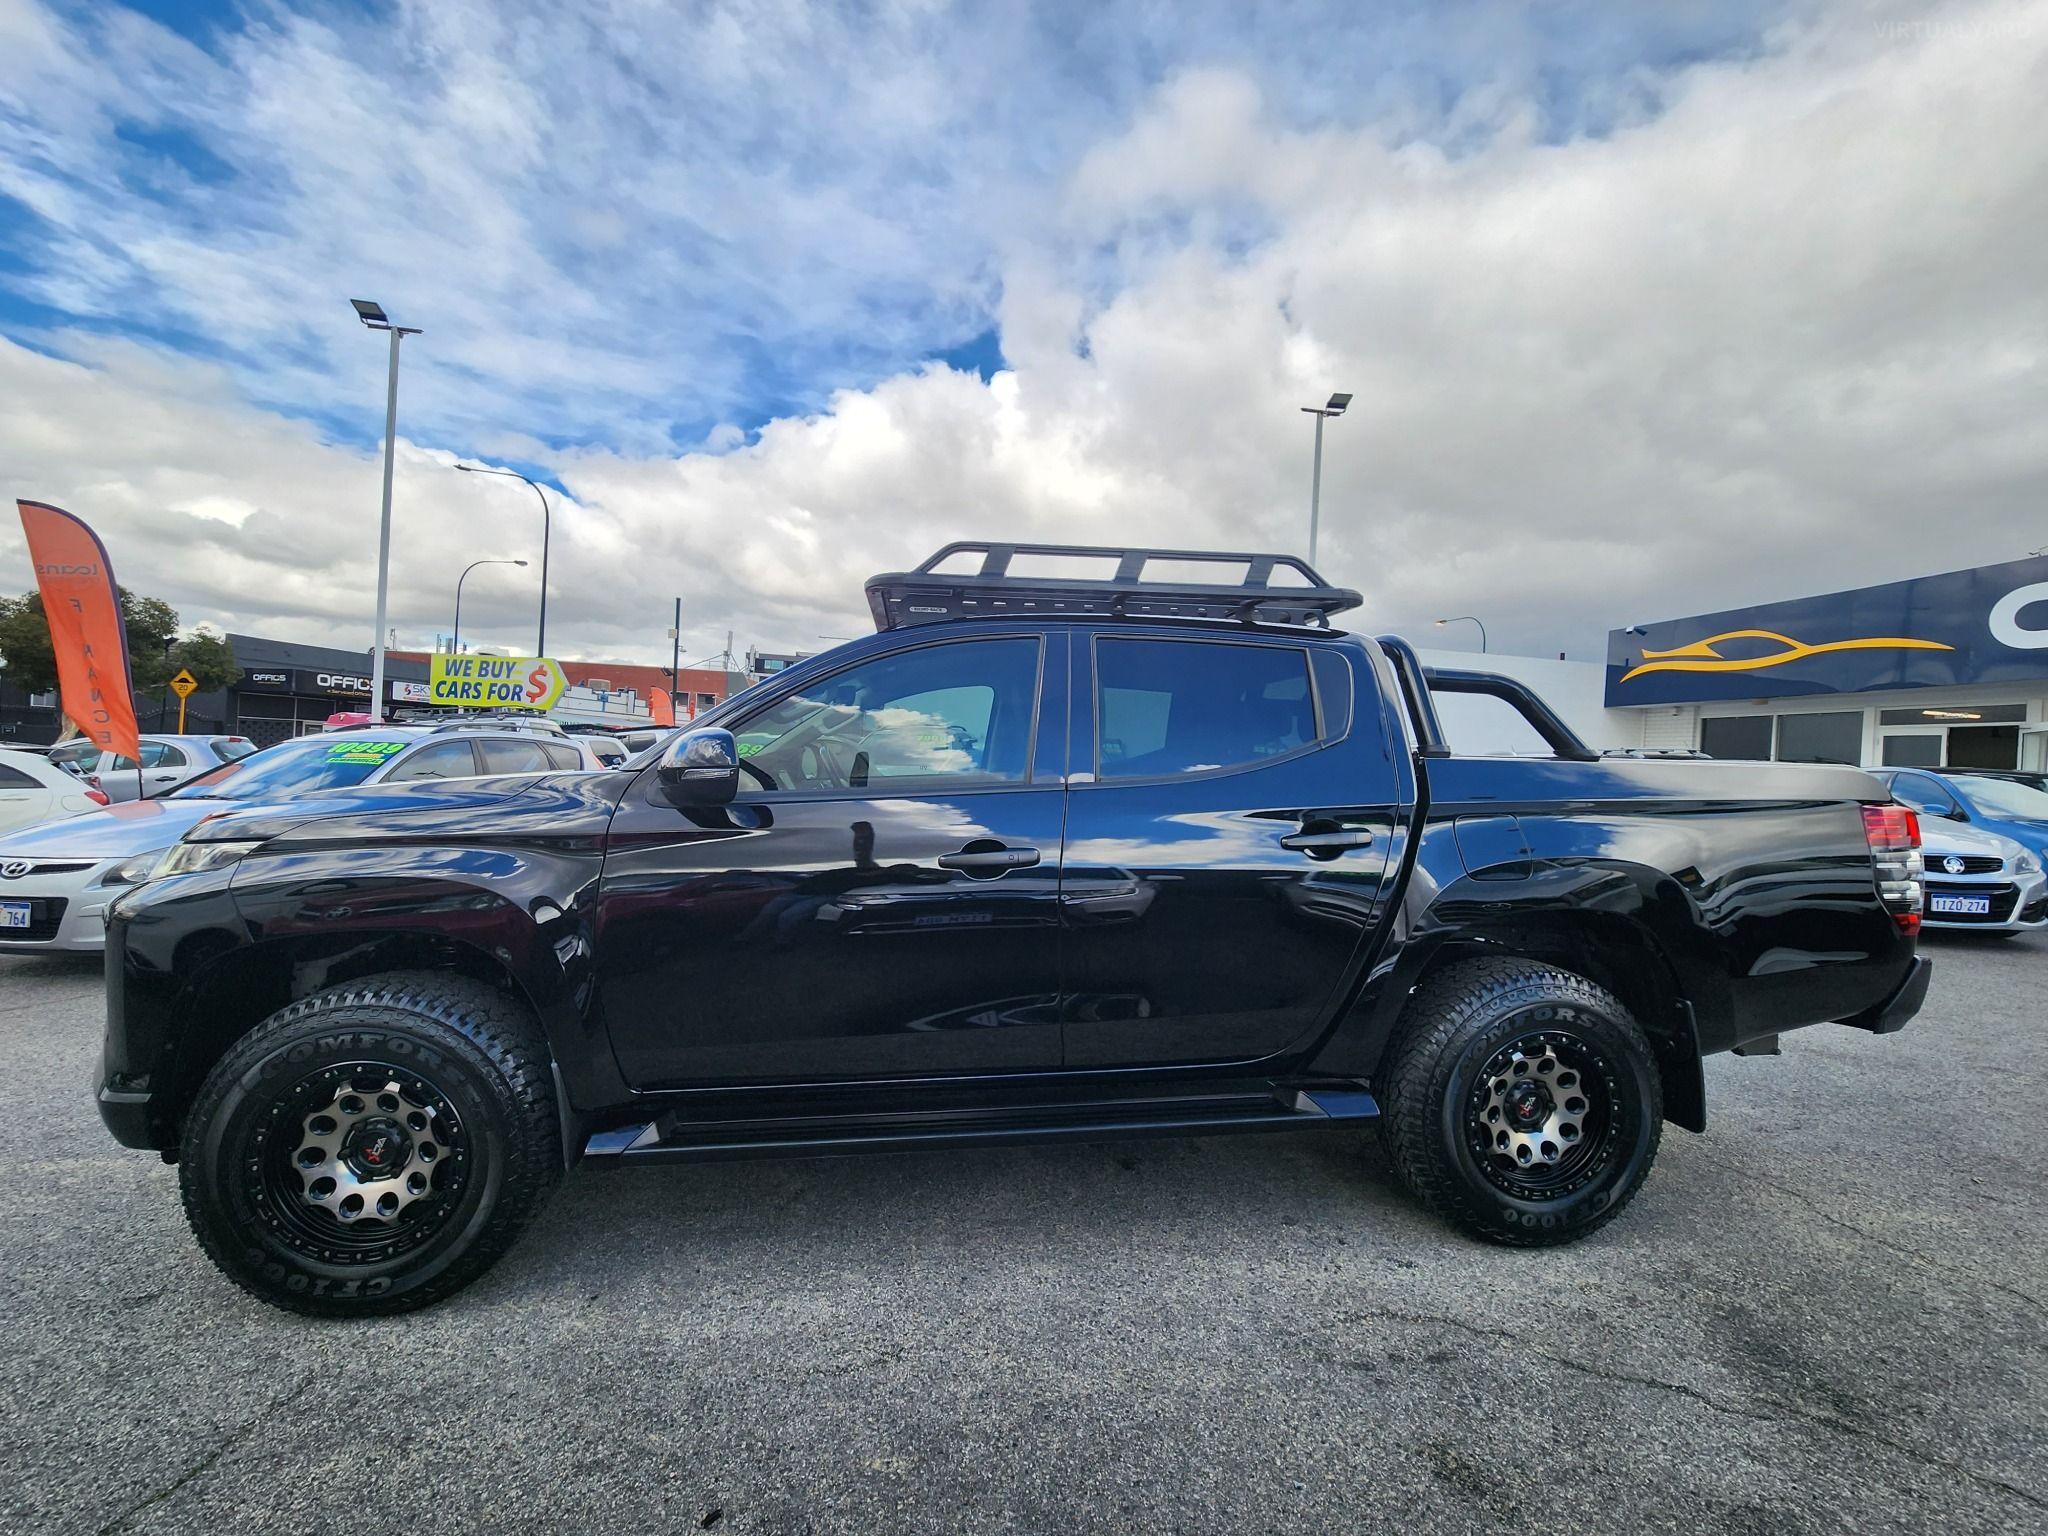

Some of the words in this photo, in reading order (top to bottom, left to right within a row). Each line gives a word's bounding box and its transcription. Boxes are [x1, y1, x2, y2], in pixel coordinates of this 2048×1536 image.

[445, 659, 473, 677] WE
[477, 660, 517, 679] BUY
[412, 684, 431, 694] SK
[435, 680, 481, 699] CARS
[487, 682, 523, 702] FOR
